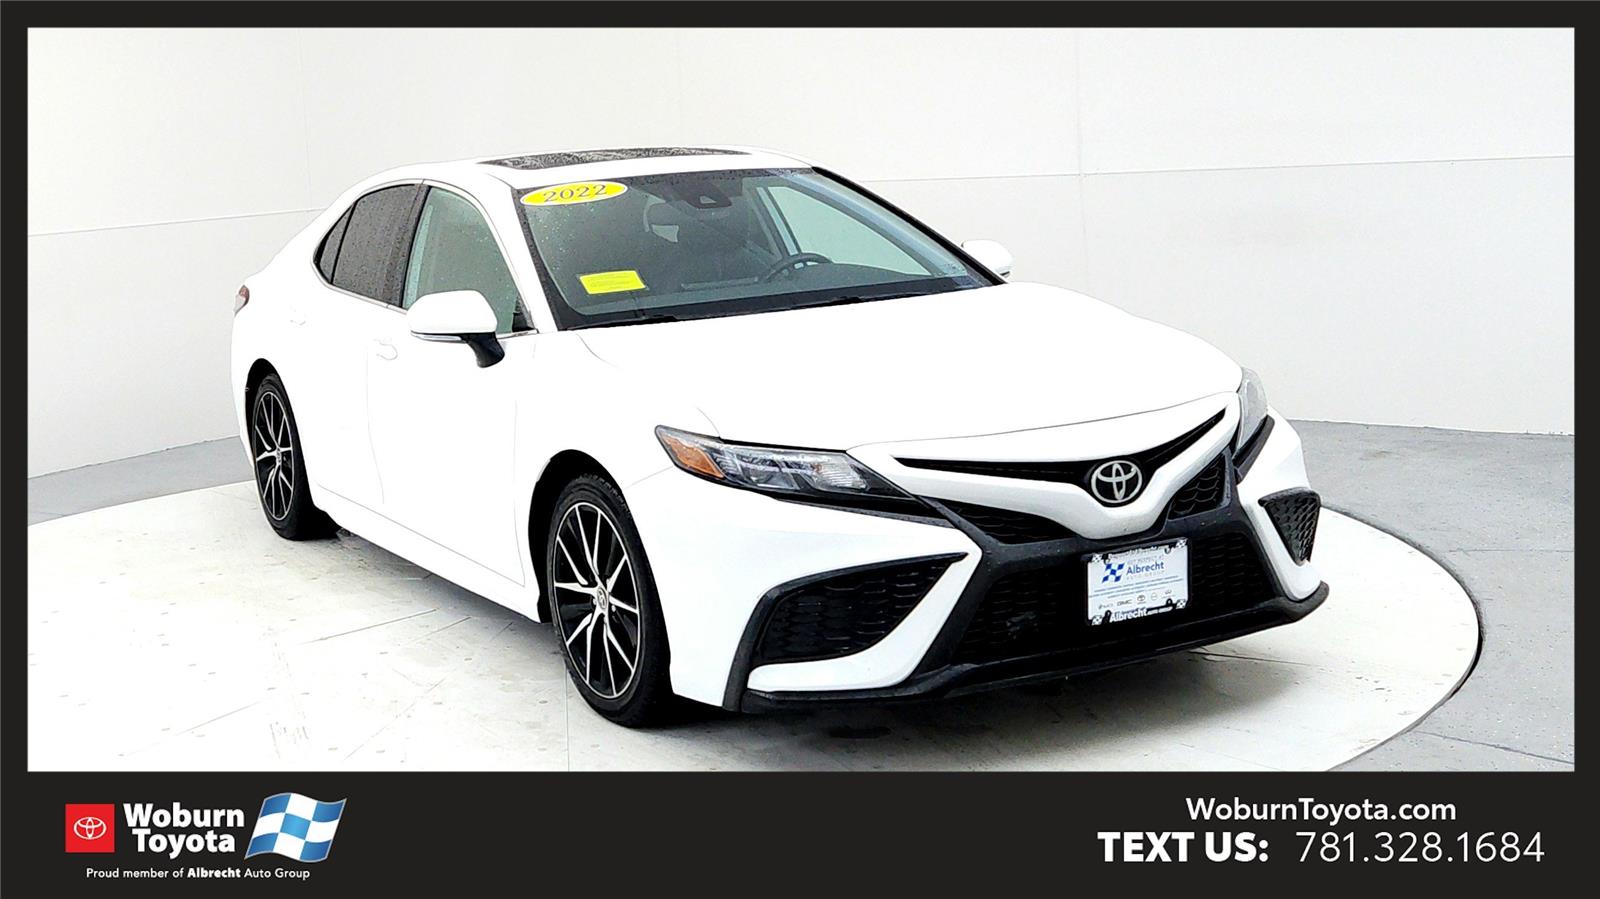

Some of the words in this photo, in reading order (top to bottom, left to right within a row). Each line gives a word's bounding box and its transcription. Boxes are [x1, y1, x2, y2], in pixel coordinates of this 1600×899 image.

[543, 184, 607, 202] 2022
[1126, 561, 1165, 575] Albrecht
[1109, 607, 1148, 623] Albrecht
